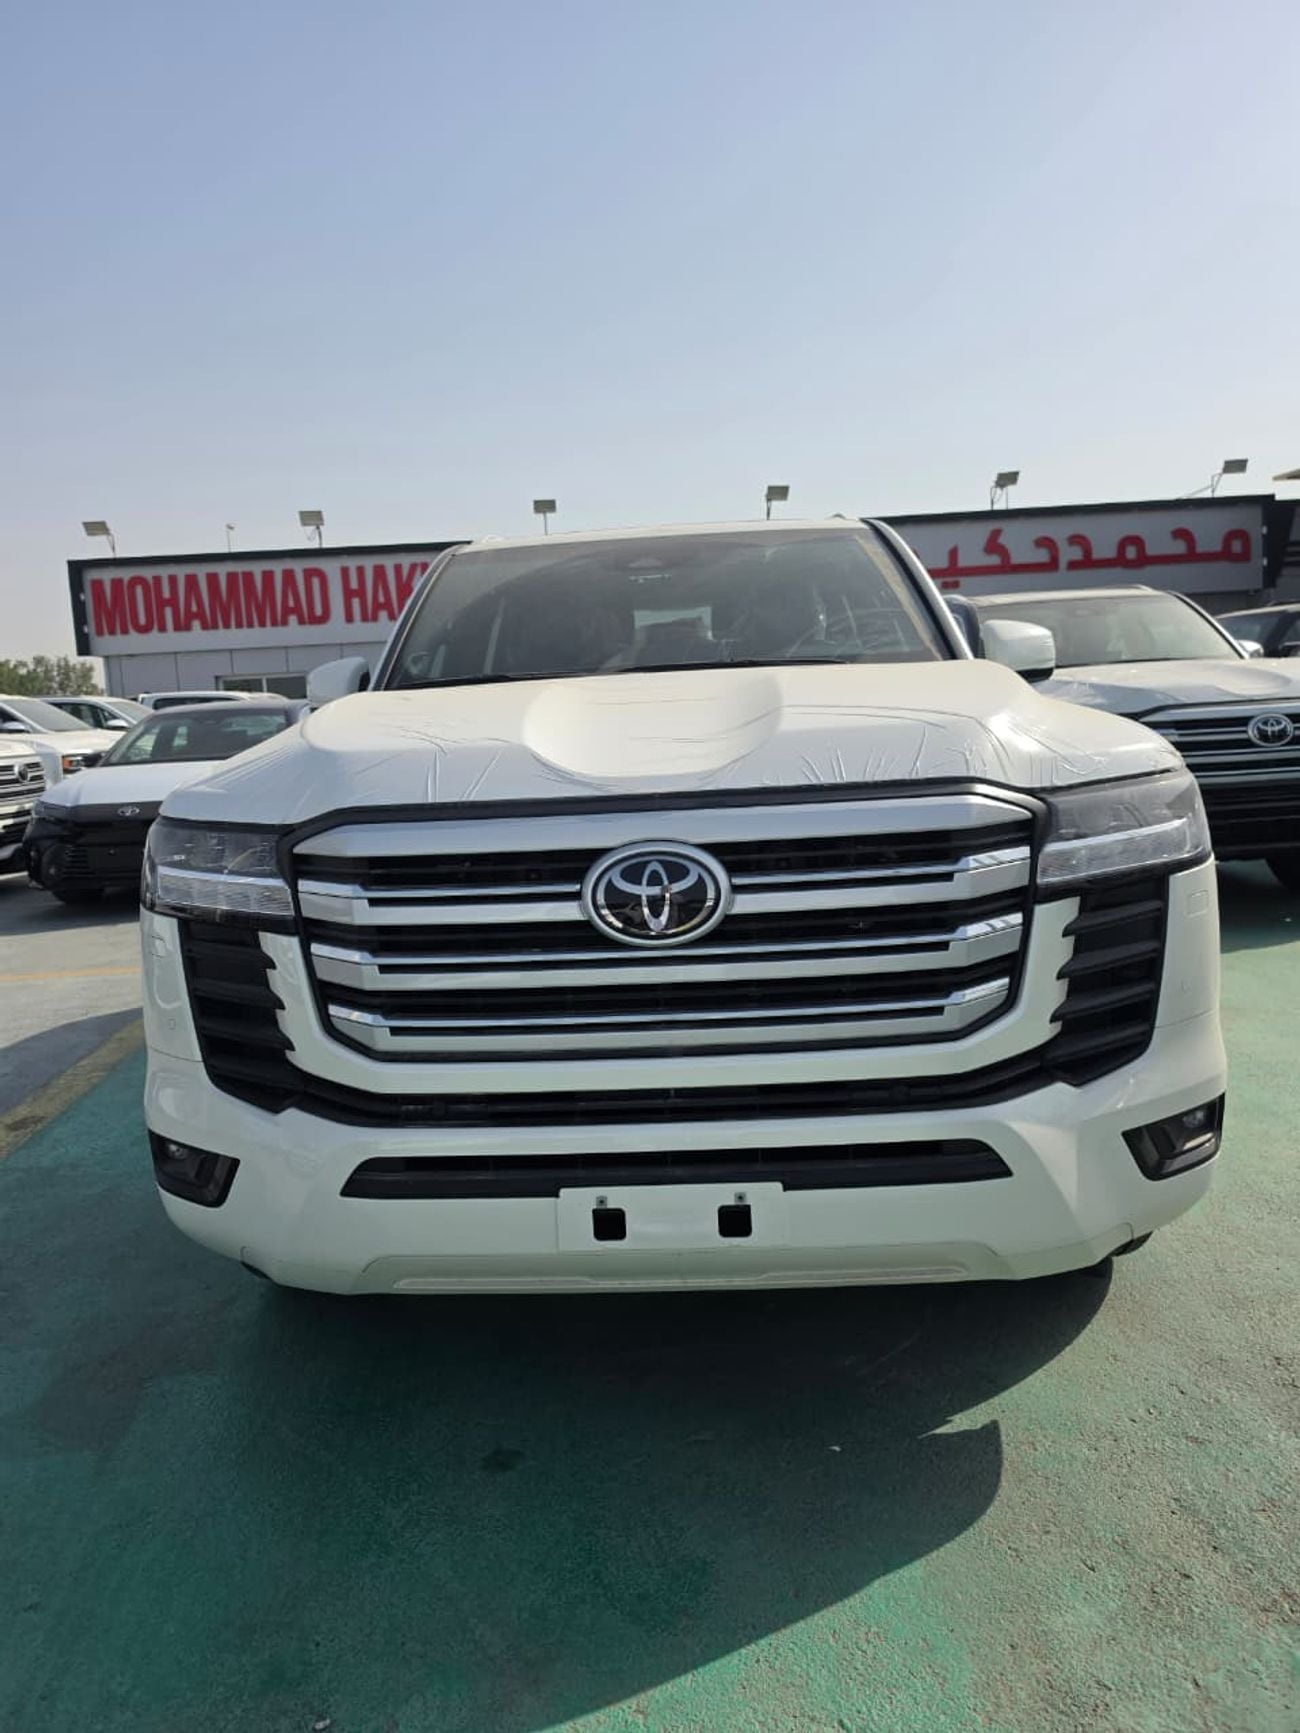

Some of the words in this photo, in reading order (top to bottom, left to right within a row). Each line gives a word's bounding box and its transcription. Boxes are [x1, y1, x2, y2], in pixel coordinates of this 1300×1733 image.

[913, 528, 1060, 589] حكي
[1066, 527, 1252, 570] محمد
[90, 567, 332, 637] MOHAMMAD
[340, 562, 429, 624] HAK
